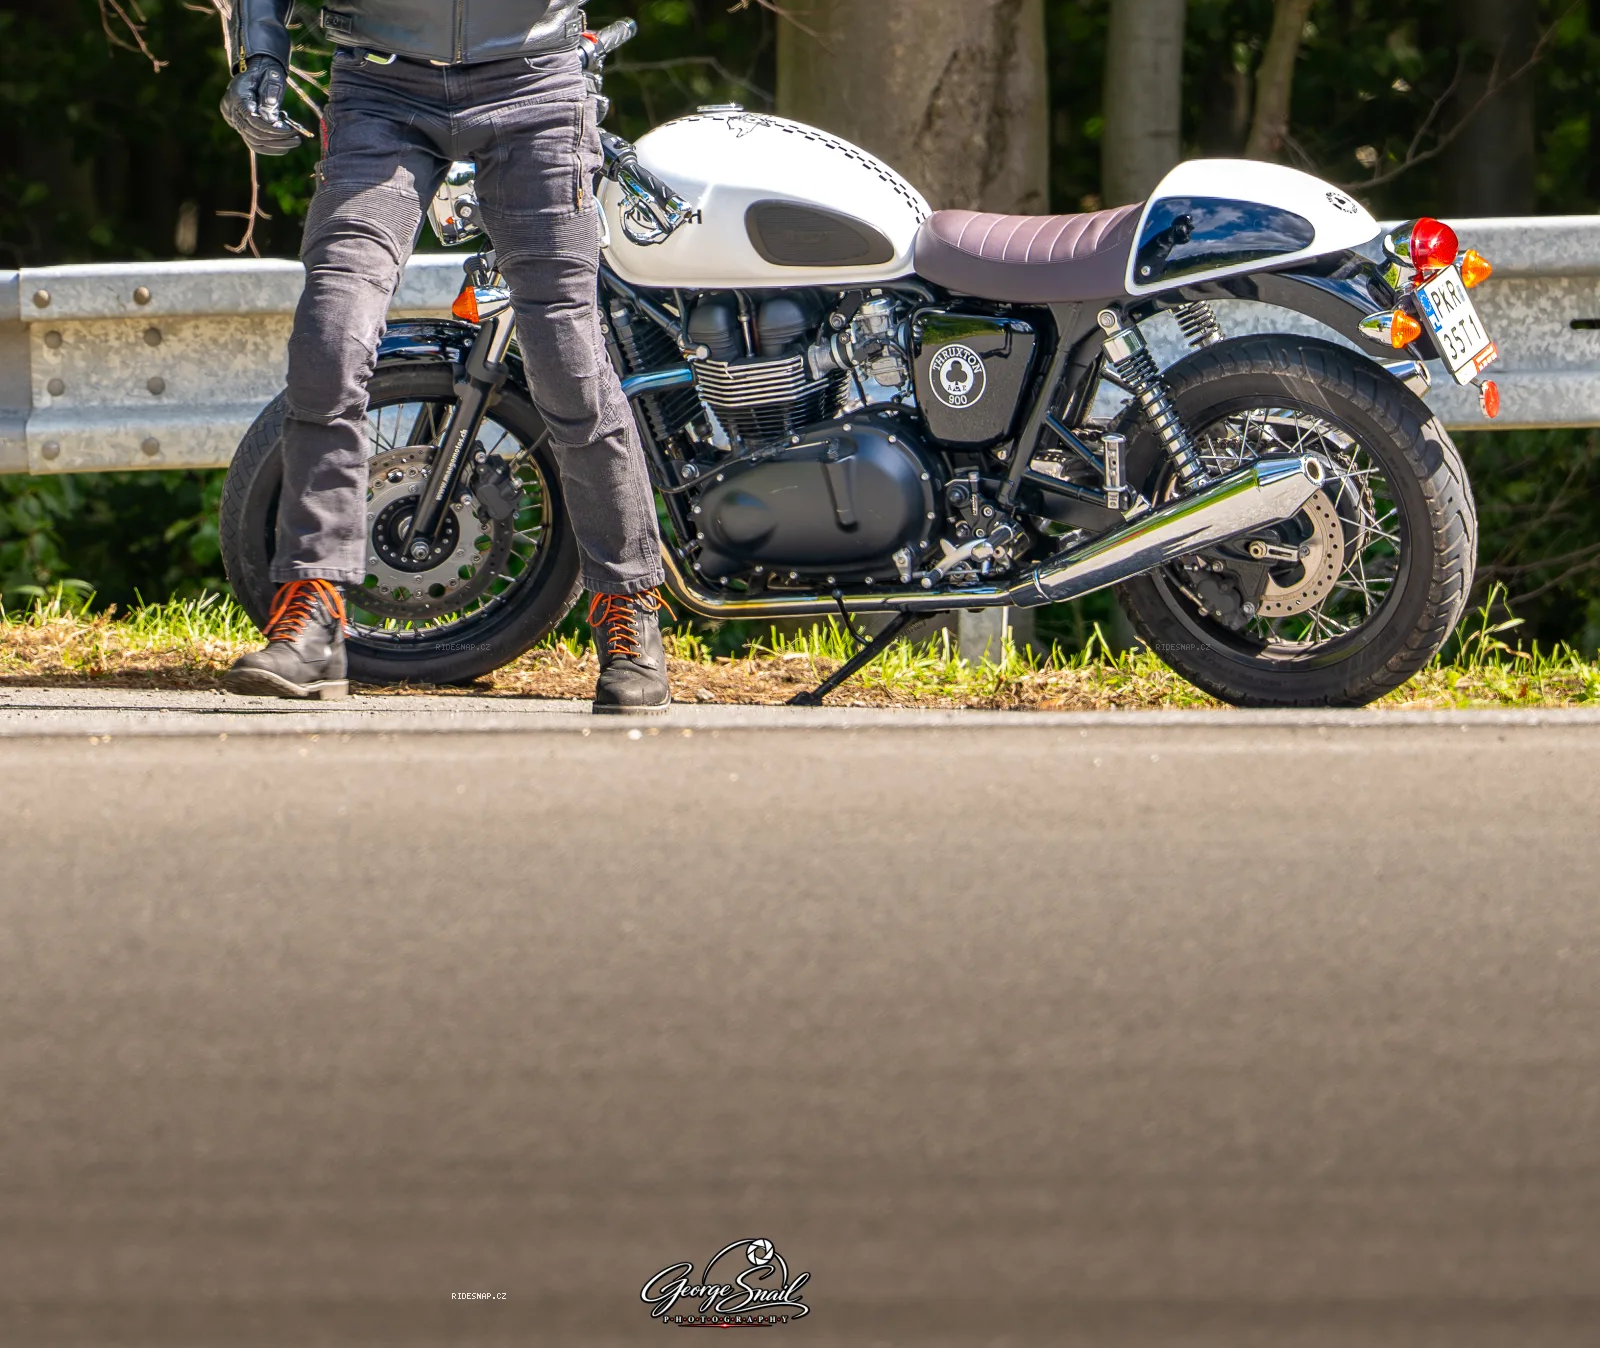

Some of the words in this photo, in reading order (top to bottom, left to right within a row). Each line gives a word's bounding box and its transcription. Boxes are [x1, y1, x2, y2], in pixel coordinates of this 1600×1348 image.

[1431, 279, 1461, 319] PKR
[933, 348, 982, 373] THRUXTON
[948, 395, 968, 405] 900
